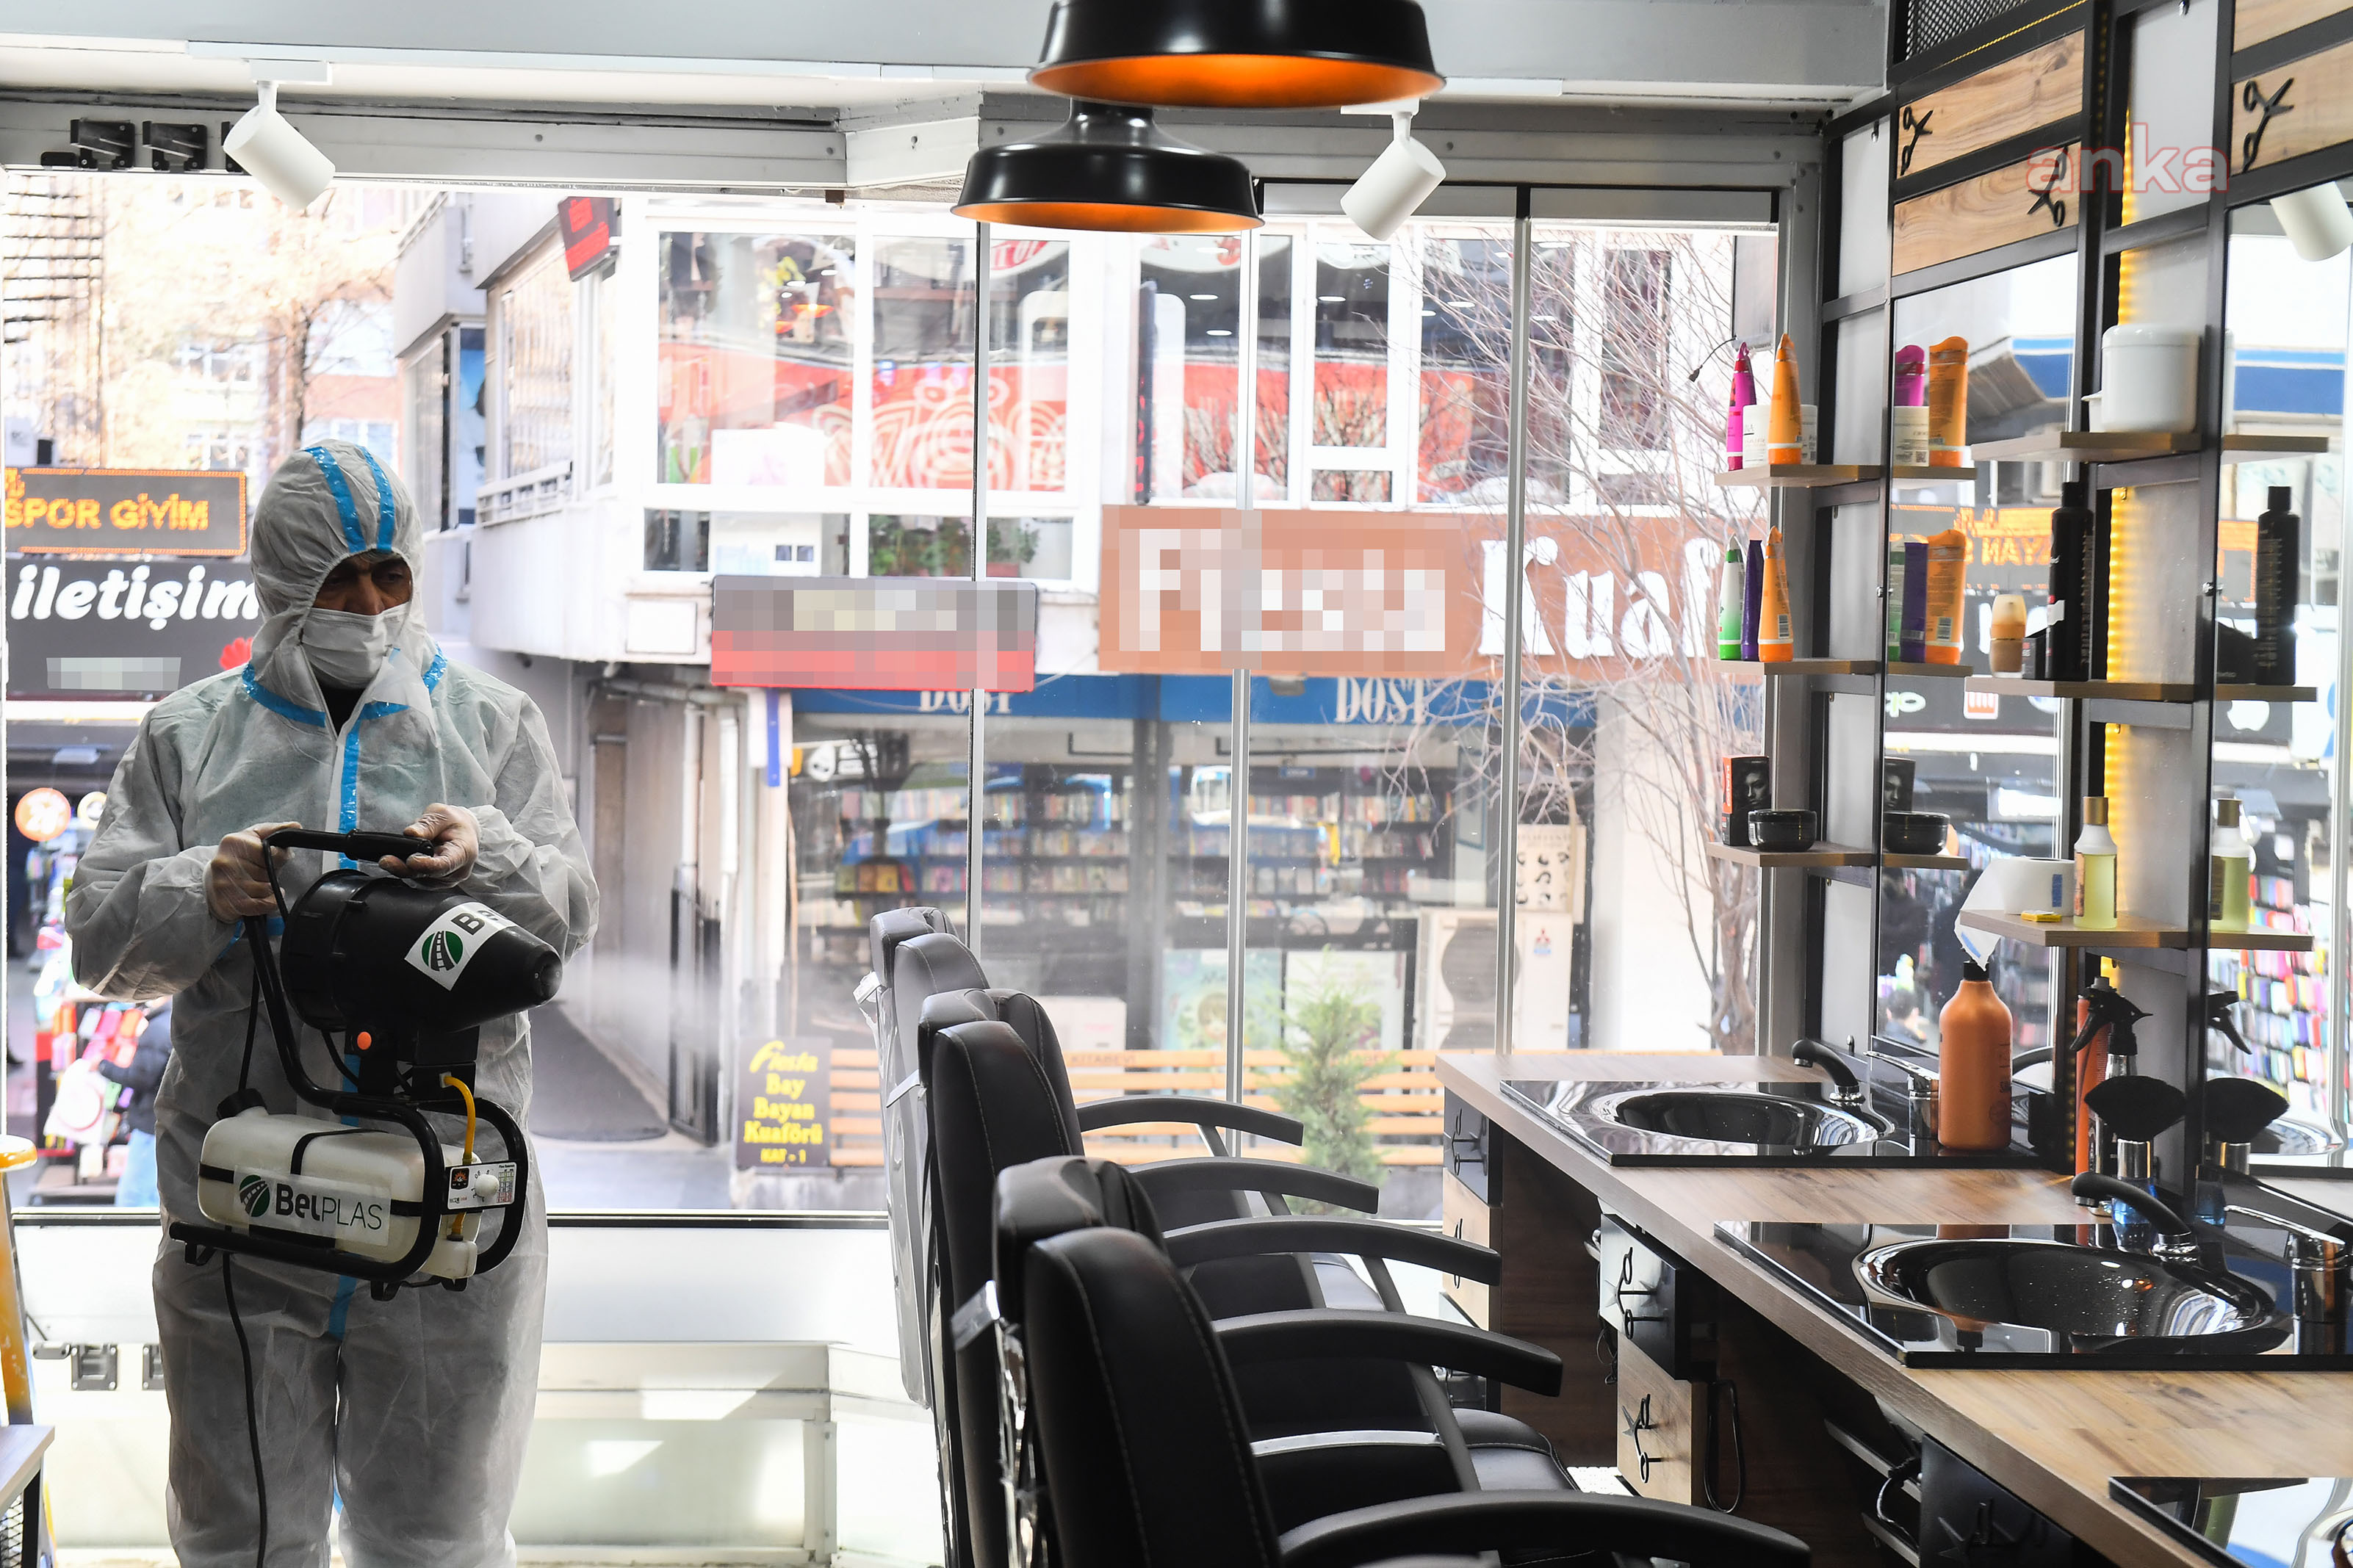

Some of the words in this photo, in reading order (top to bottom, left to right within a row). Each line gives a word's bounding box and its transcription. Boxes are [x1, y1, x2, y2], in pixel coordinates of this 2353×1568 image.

[5, 497, 102, 530] SPOR
[109, 494, 209, 531] GİYİM
[11, 565, 259, 631] iletişim
[1477, 536, 1721, 659] Kuaf
[765, 1072, 806, 1099] Bay
[753, 1096, 815, 1124] Bayan
[275, 1182, 383, 1230] BelPLAS
